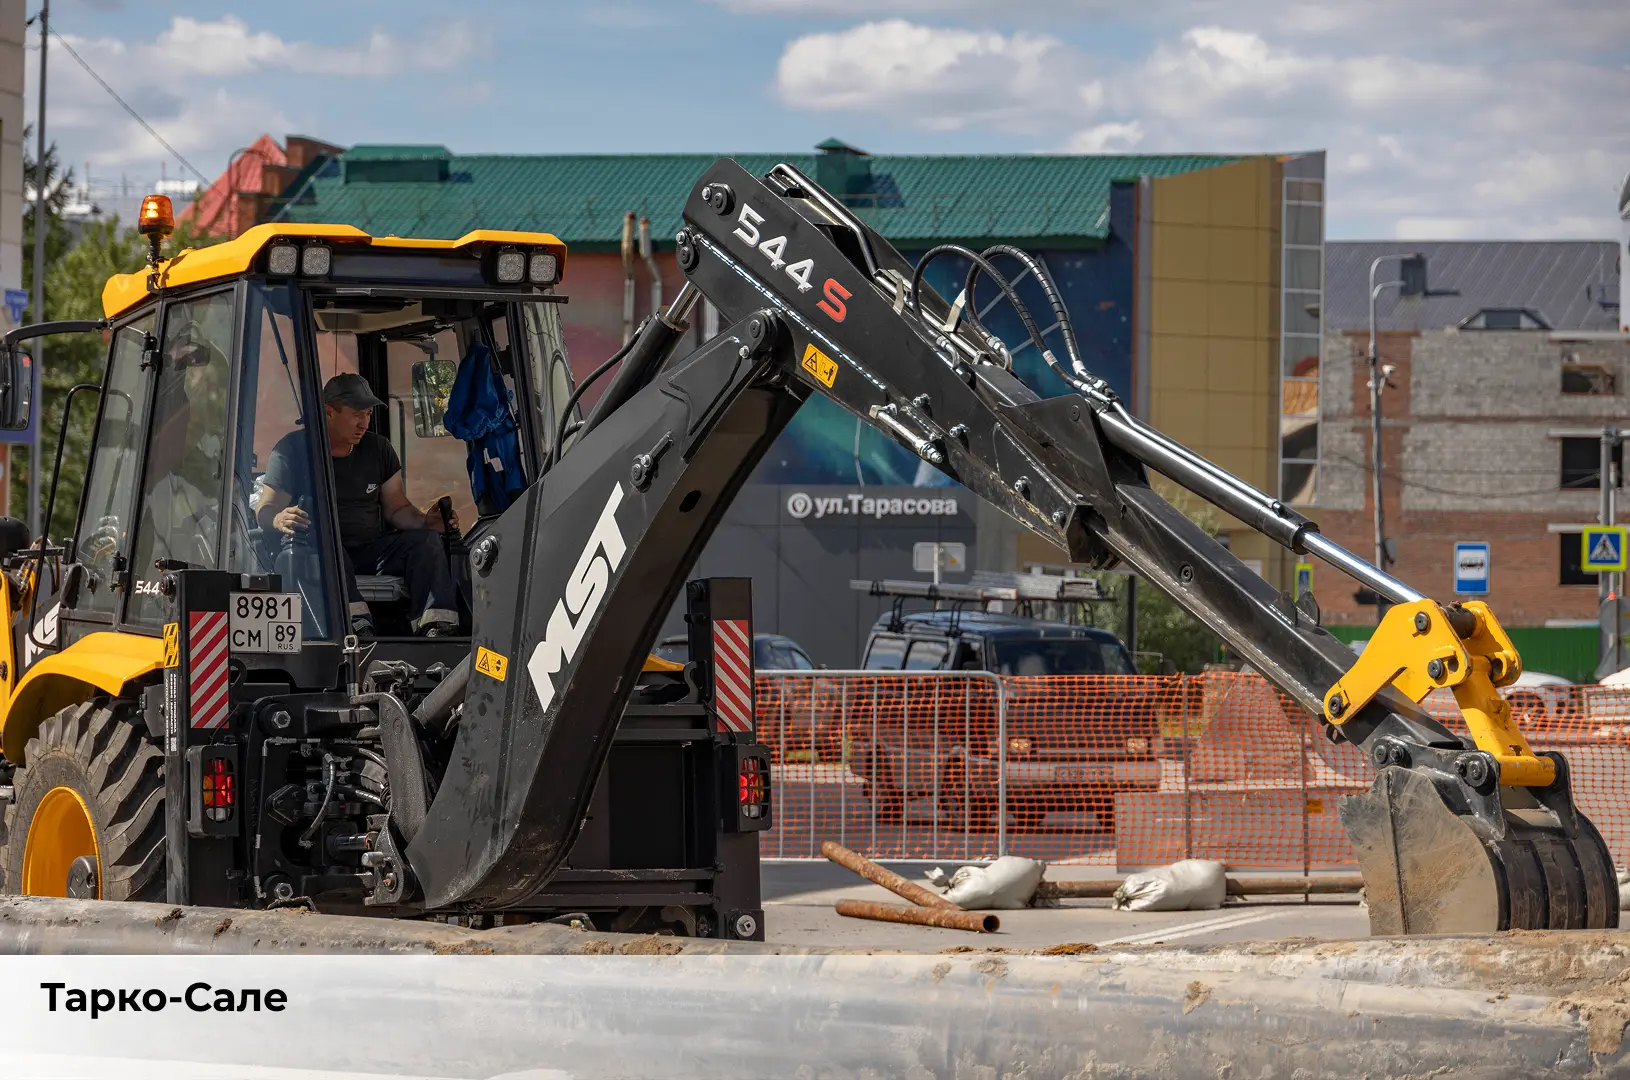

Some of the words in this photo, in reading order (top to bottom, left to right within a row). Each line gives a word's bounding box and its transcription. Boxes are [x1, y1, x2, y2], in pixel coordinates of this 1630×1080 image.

[732, 202, 814, 294] 544
[815, 277, 853, 323] S
[814, 494, 958, 520] ул.Тарасова
[134, 580, 160, 595] 544
[527, 480, 627, 714] MST
[236, 596, 292, 620] 8981
[24, 600, 61, 668] MS
[275, 625, 296, 643] 89
[277, 642, 294, 650] RUS
